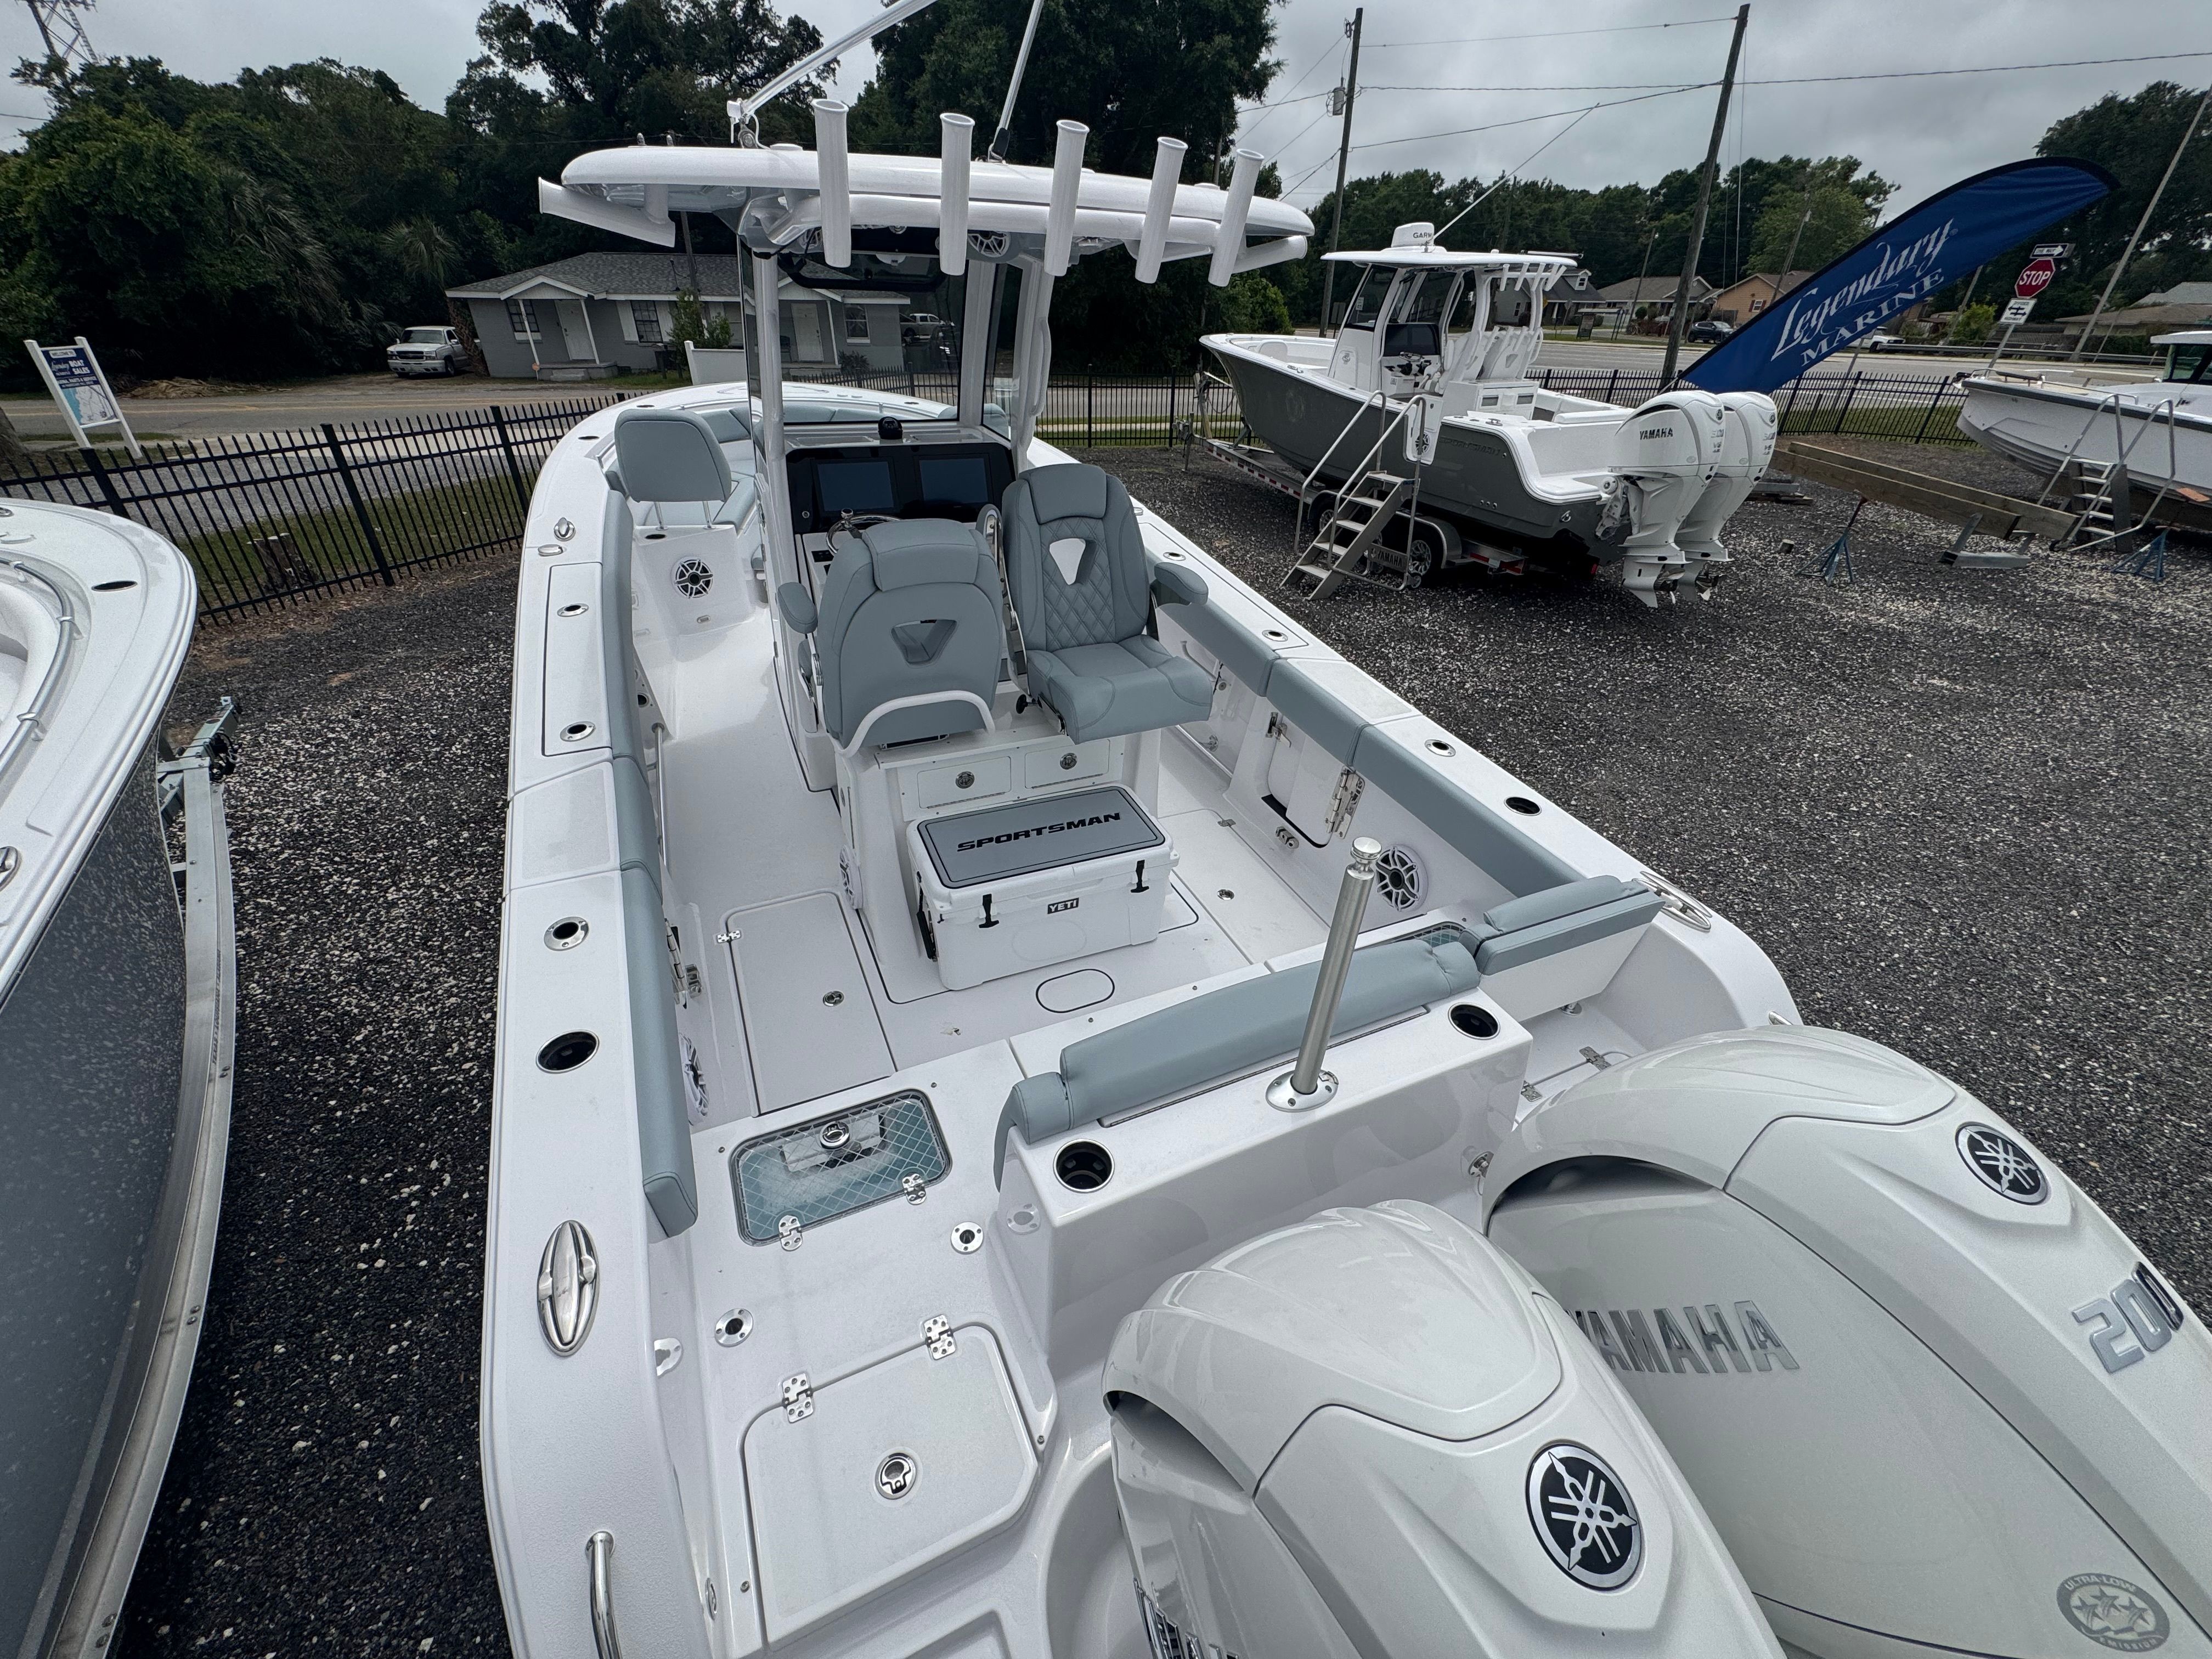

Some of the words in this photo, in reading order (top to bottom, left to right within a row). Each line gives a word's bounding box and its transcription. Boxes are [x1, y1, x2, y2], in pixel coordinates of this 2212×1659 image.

[2019, 271, 2051, 285] STOP
[1771, 218, 1954, 362] Legendary
[1801, 268, 1945, 366] MARINE
[72, 366, 91, 375] SALES
[1639, 427, 1673, 440] YAMAHA
[1378, 550, 1403, 567] YAMAHA
[957, 812, 1121, 851] SPORTSMAN
[1049, 900, 1078, 912] YETI
